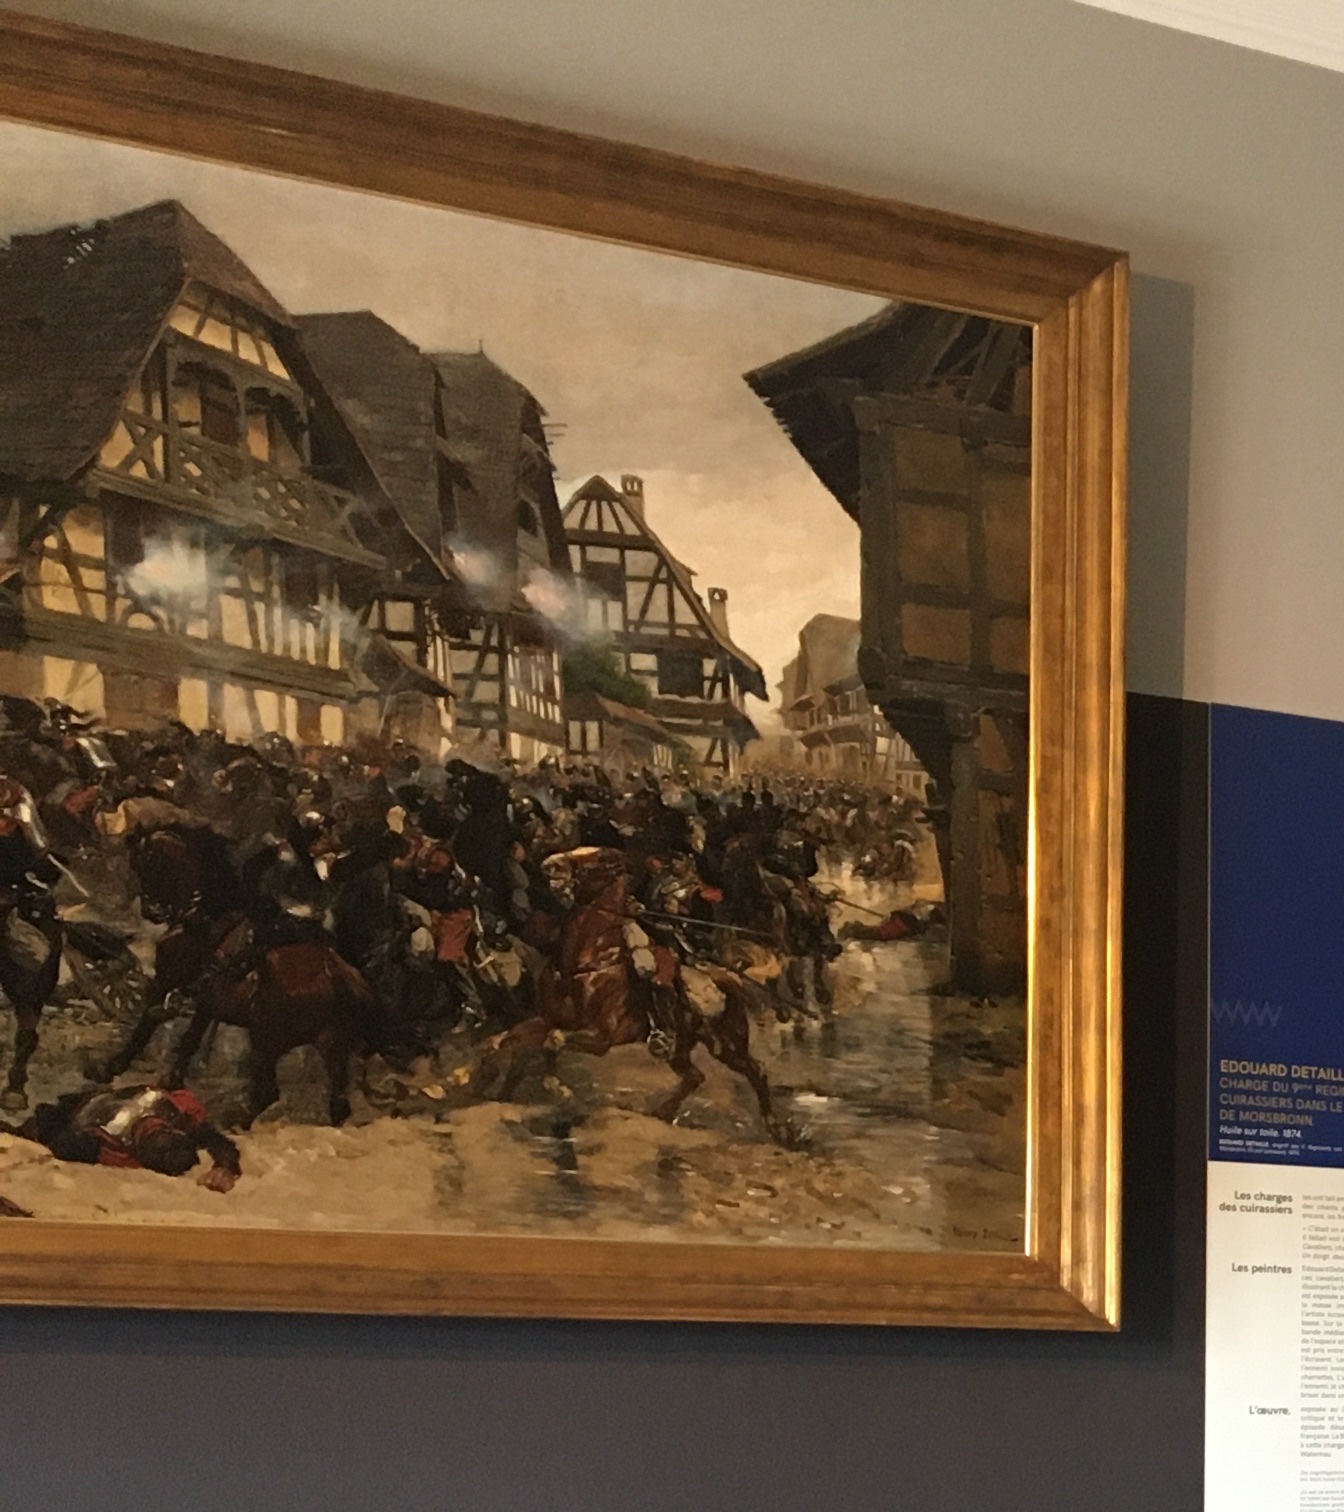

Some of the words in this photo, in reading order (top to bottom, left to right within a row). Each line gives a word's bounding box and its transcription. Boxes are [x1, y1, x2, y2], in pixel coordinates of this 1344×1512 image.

[1220, 1060, 1287, 1077] EDOUARD
[1220, 1078, 1268, 1091] CHARGE
[1273, 1081, 1288, 1092] DU
[1220, 1094, 1292, 1109] CUIRASSIERS
[1296, 1099, 1326, 1111] DANS
[1330, 1102, 1342, 1112] LE
[1220, 1110, 1234, 1121] DE
[1234, 1191, 1251, 1200] Les
[1254, 1192, 1292, 1204] charges
[1219, 1202, 1237, 1211] des
[1240, 1203, 1292, 1214] cuirassiers
[1232, 1262, 1248, 1272] Les
[1252, 1264, 1292, 1274] peintres
